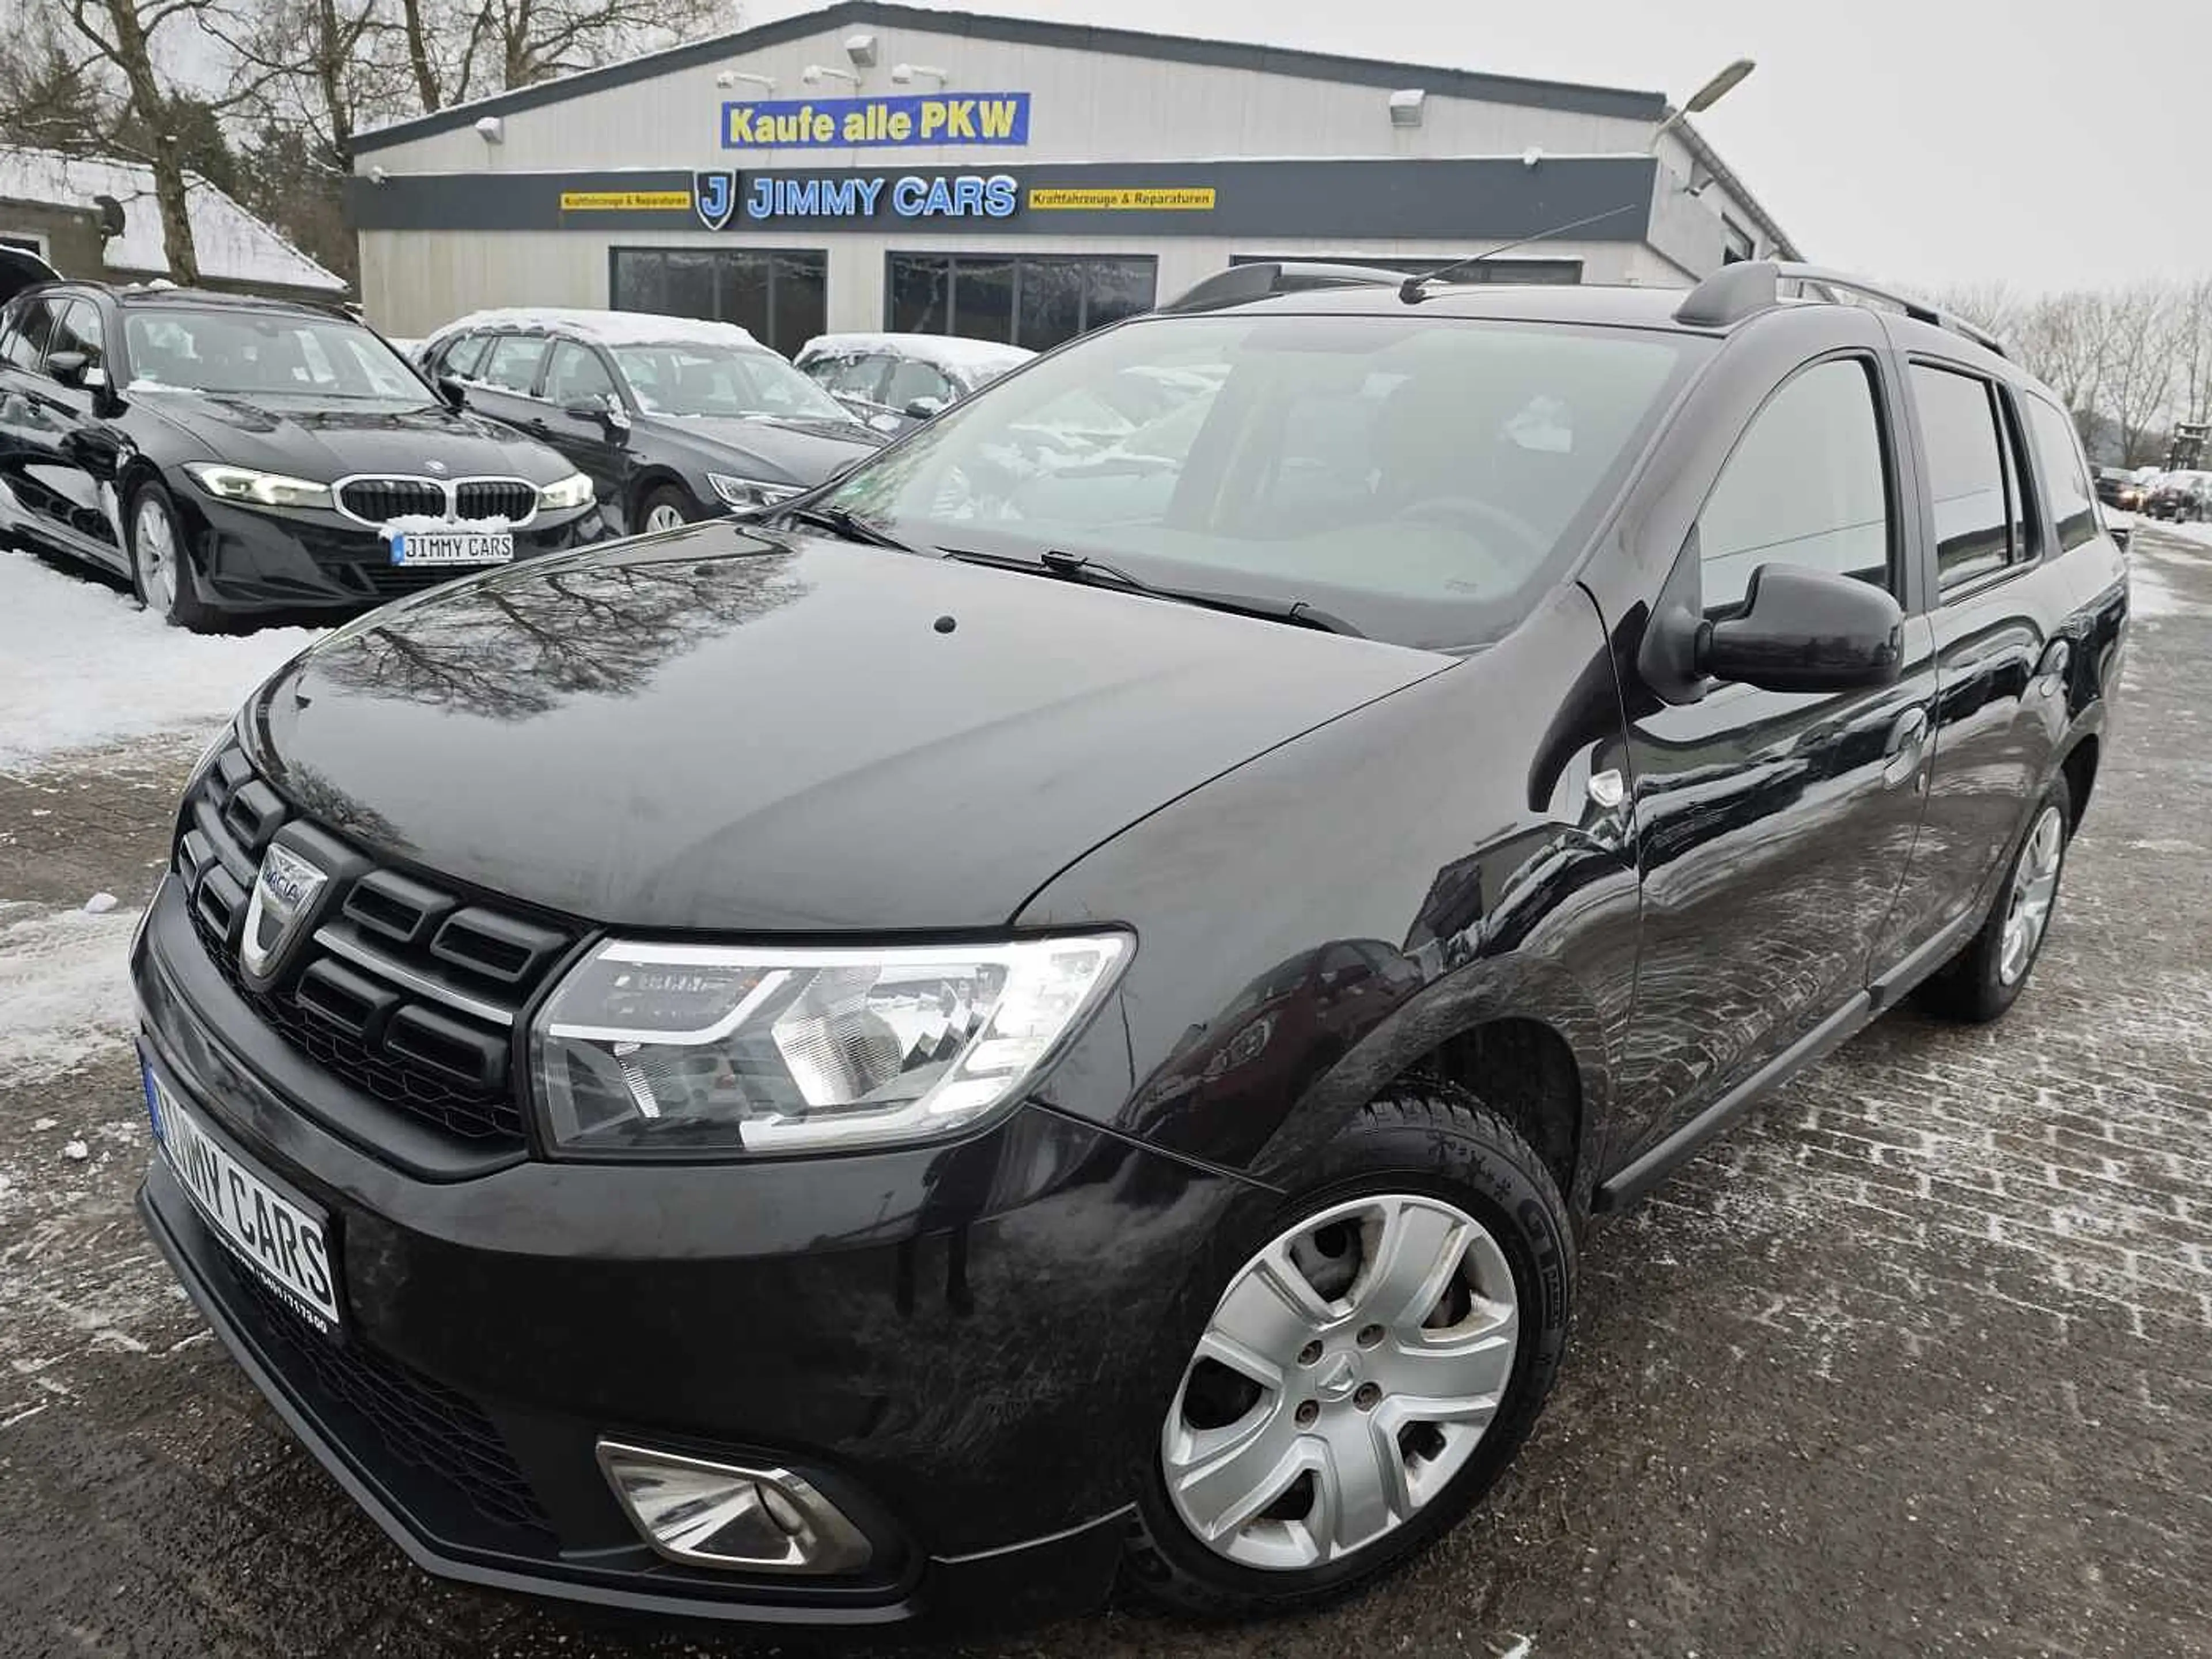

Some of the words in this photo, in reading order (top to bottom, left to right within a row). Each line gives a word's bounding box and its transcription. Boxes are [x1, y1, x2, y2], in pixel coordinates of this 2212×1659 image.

[729, 106, 835, 143] Kaufe
[843, 104, 912, 142] alle
[921, 100, 1018, 139] PKW
[701, 176, 728, 217] J
[748, 177, 885, 219] JIMMY
[892, 175, 1018, 218] CARS
[1034, 191, 1118, 208] Kraftfahrzeuge
[1121, 191, 1130, 204] &
[1134, 190, 1210, 206] Reparaturen
[406, 538, 461, 558] JIMMY
[468, 537, 511, 557] CARS
[228, 1165, 332, 1306] CARS
